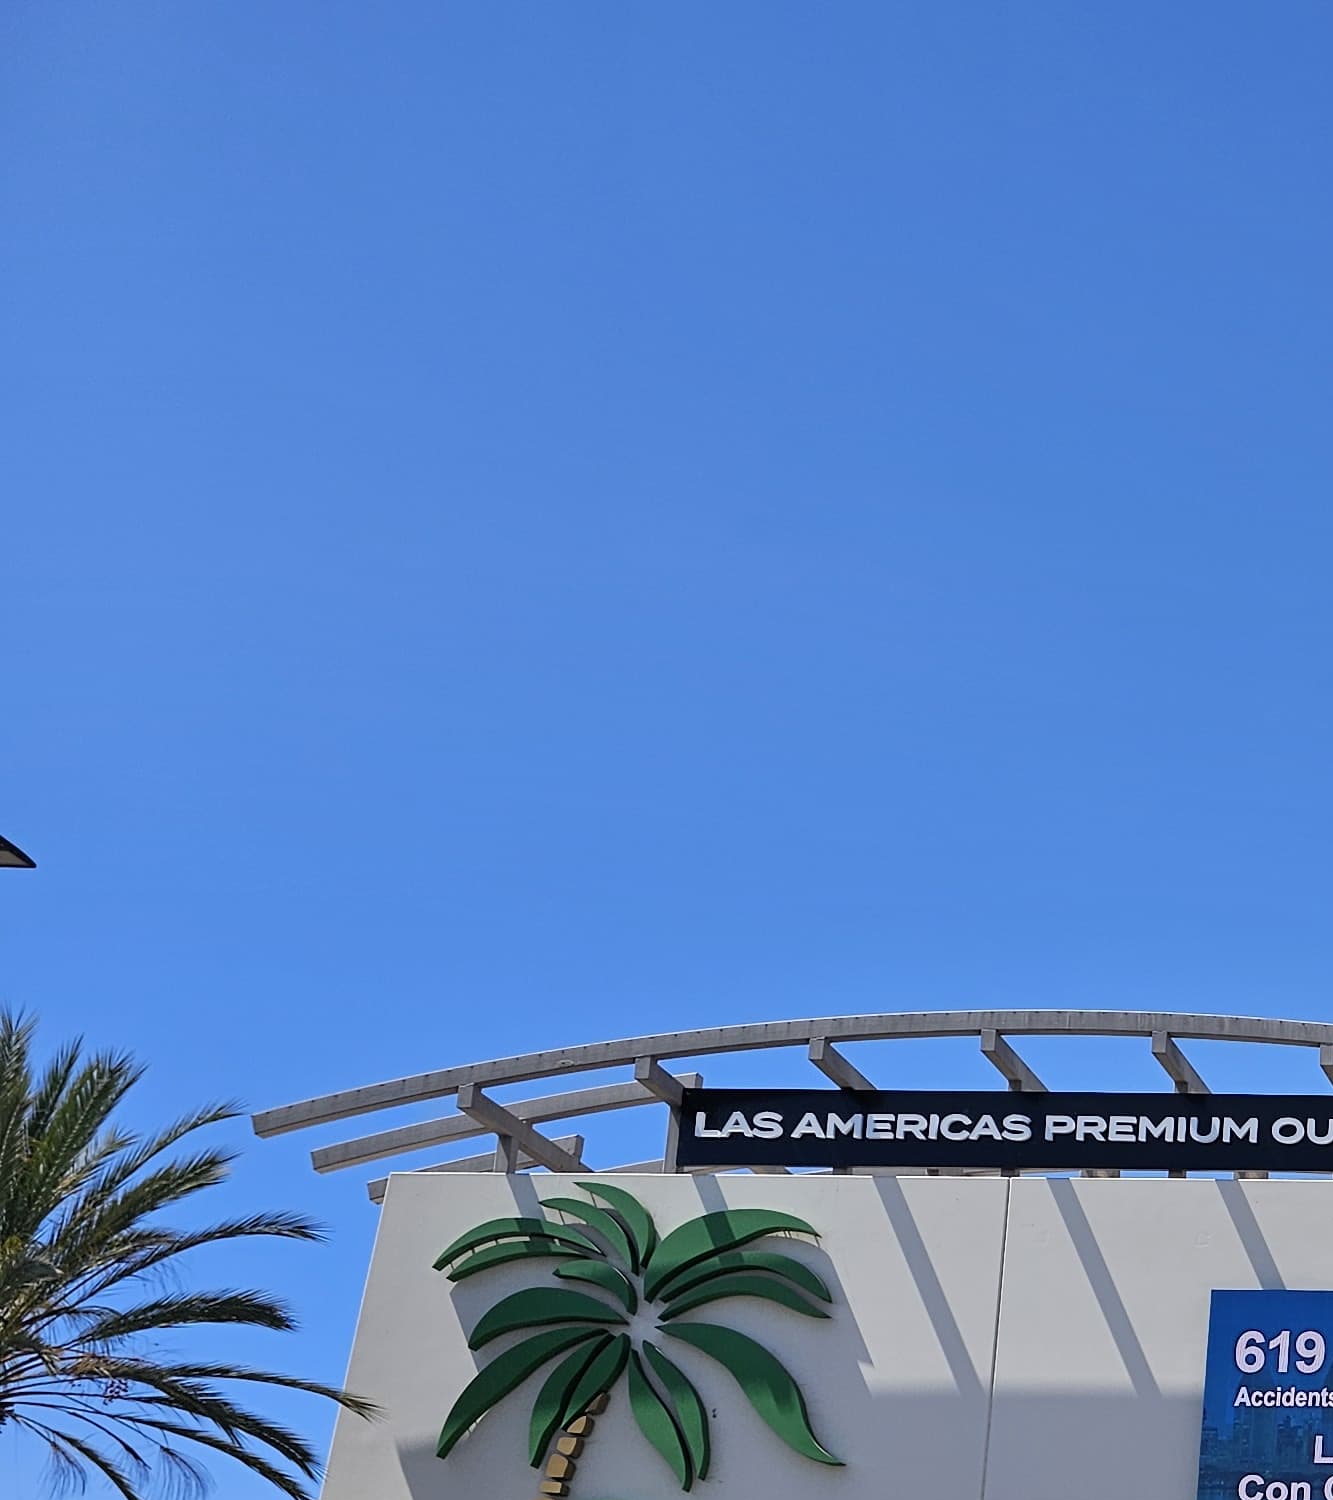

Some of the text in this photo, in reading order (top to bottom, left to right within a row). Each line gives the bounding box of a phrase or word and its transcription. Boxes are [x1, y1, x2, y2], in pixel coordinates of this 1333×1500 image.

[694, 1111, 783, 1139] LAS
[790, 1112, 1032, 1141] AMERICAS
[1044, 1115, 1258, 1143] PREMIUM
[1234, 1330, 1326, 1374] 619
